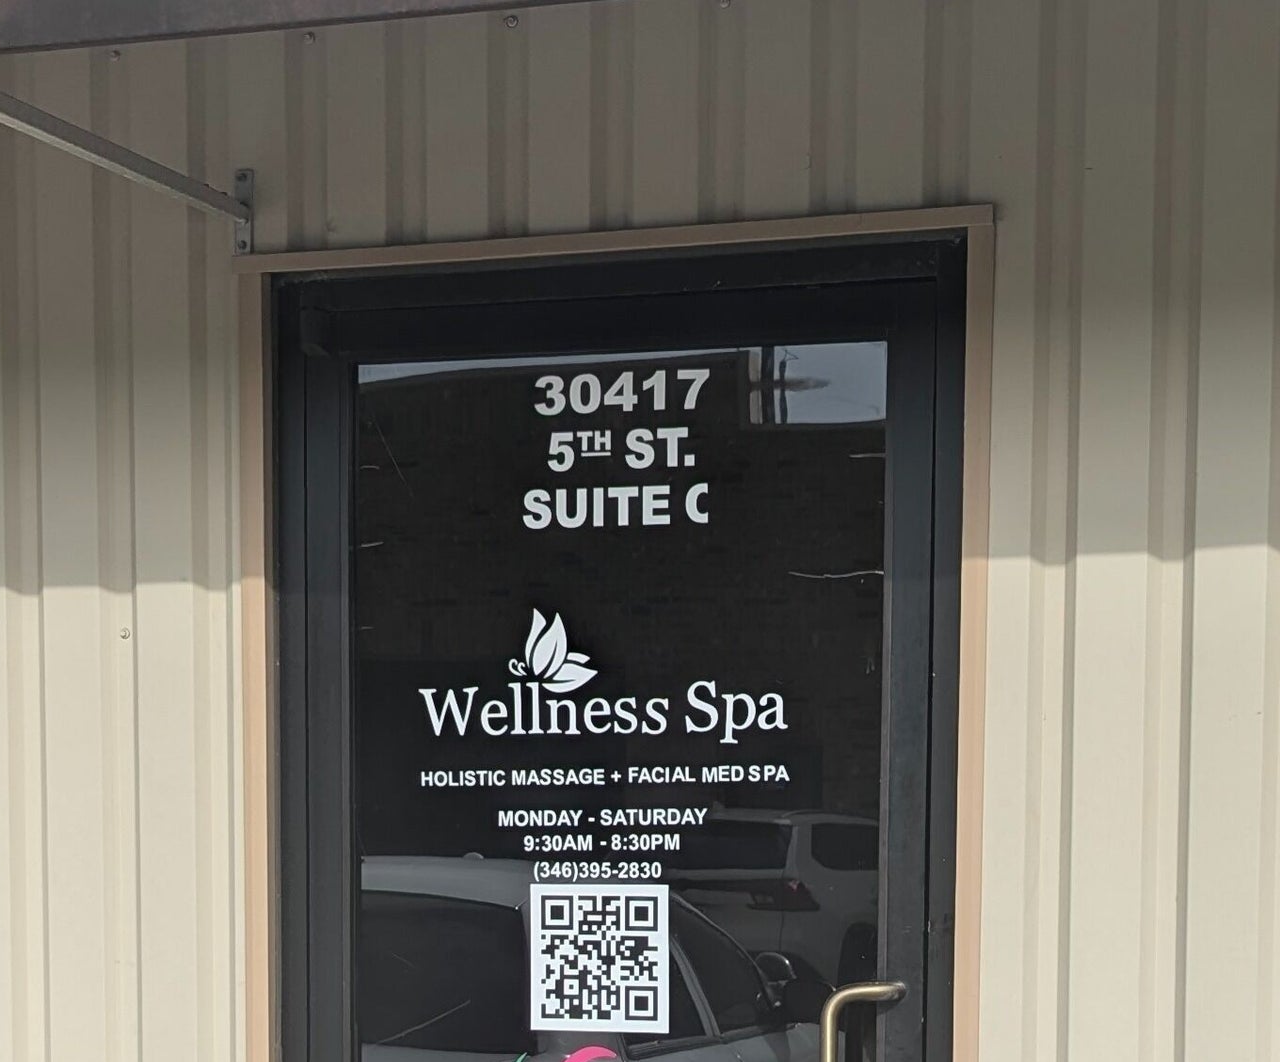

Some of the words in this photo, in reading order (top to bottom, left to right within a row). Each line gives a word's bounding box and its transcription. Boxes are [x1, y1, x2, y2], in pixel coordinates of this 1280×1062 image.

[534, 369, 710, 416] 30417
[547, 430, 612, 472] 5TH
[625, 427, 695, 469] ST.
[522, 485, 671, 530] SUITE
[418, 683, 669, 737] Wellness
[685, 680, 789, 744] Spa
[420, 769, 506, 787] HOLISTIC
[511, 768, 606, 786] MASSAGE
[628, 766, 697, 784] FACIAL
[498, 809, 583, 827] MONDAY
[600, 807, 708, 826] SATURDAY
[523, 834, 593, 852] 9:30AM
[611, 833, 680, 851] 8:30PM
[533, 861, 662, 881] (346)395-2830
